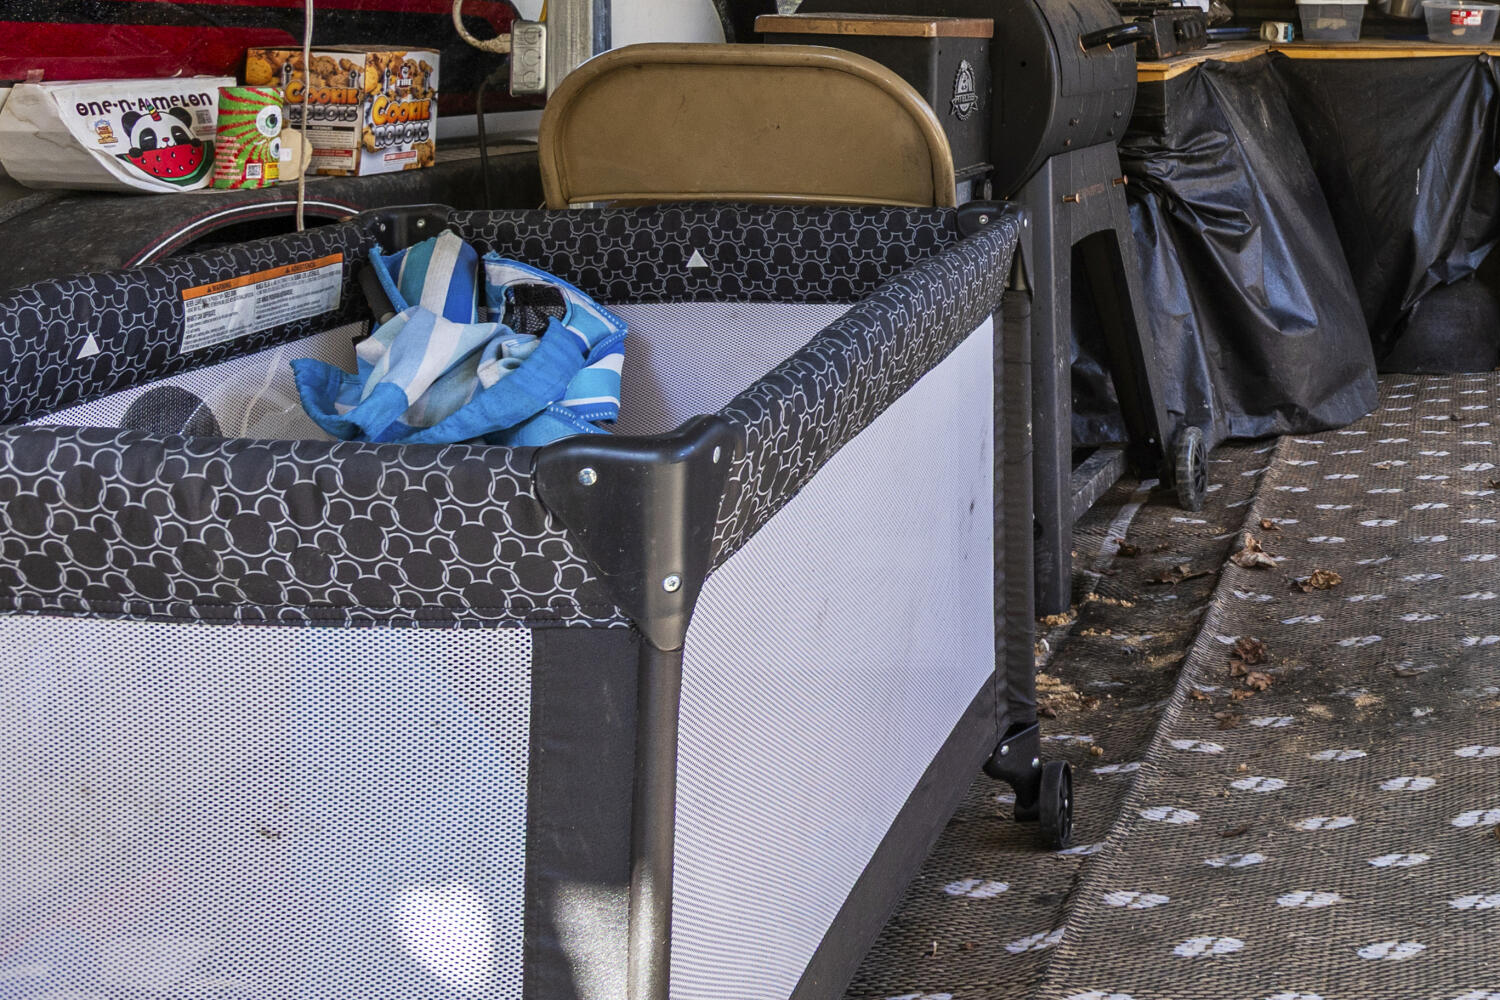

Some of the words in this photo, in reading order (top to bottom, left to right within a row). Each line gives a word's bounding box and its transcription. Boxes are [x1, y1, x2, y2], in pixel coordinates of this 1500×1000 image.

[285, 81, 359, 105] COOKIE
[289, 104, 358, 122] ROBOTS
[372, 95, 431, 125] COOKIE
[375, 122, 429, 147] ROBOTS
